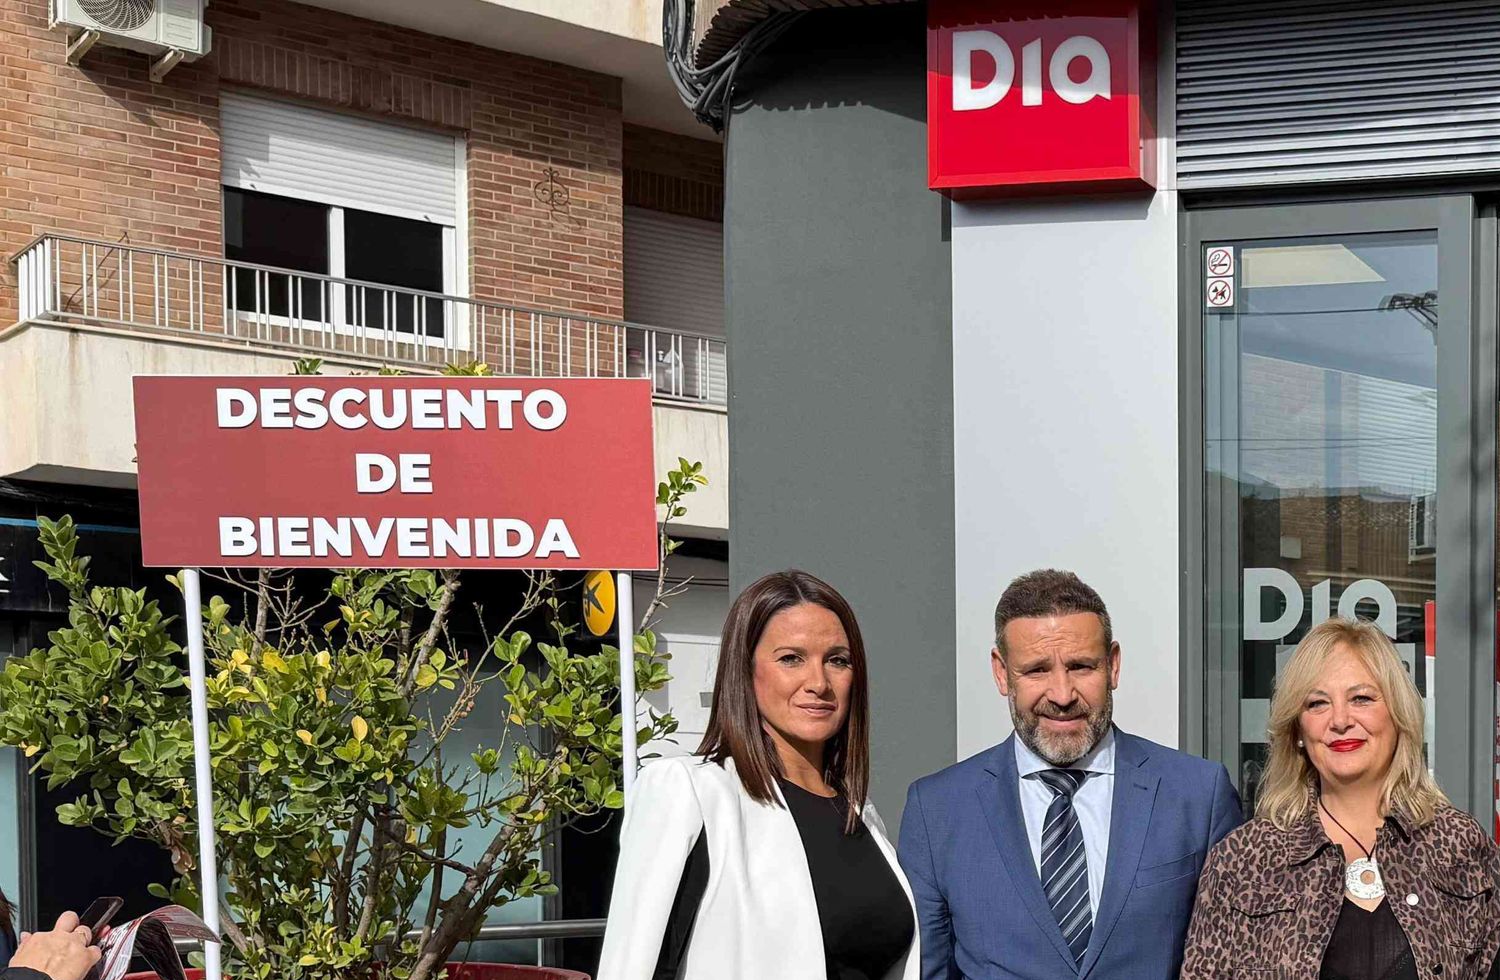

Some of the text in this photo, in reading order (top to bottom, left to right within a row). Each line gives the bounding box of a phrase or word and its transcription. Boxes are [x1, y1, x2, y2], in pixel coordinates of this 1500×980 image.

[217, 387, 567, 431] DESCUENTO
[355, 453, 433, 494] DE
[219, 516, 580, 560] BIENVENIDA
